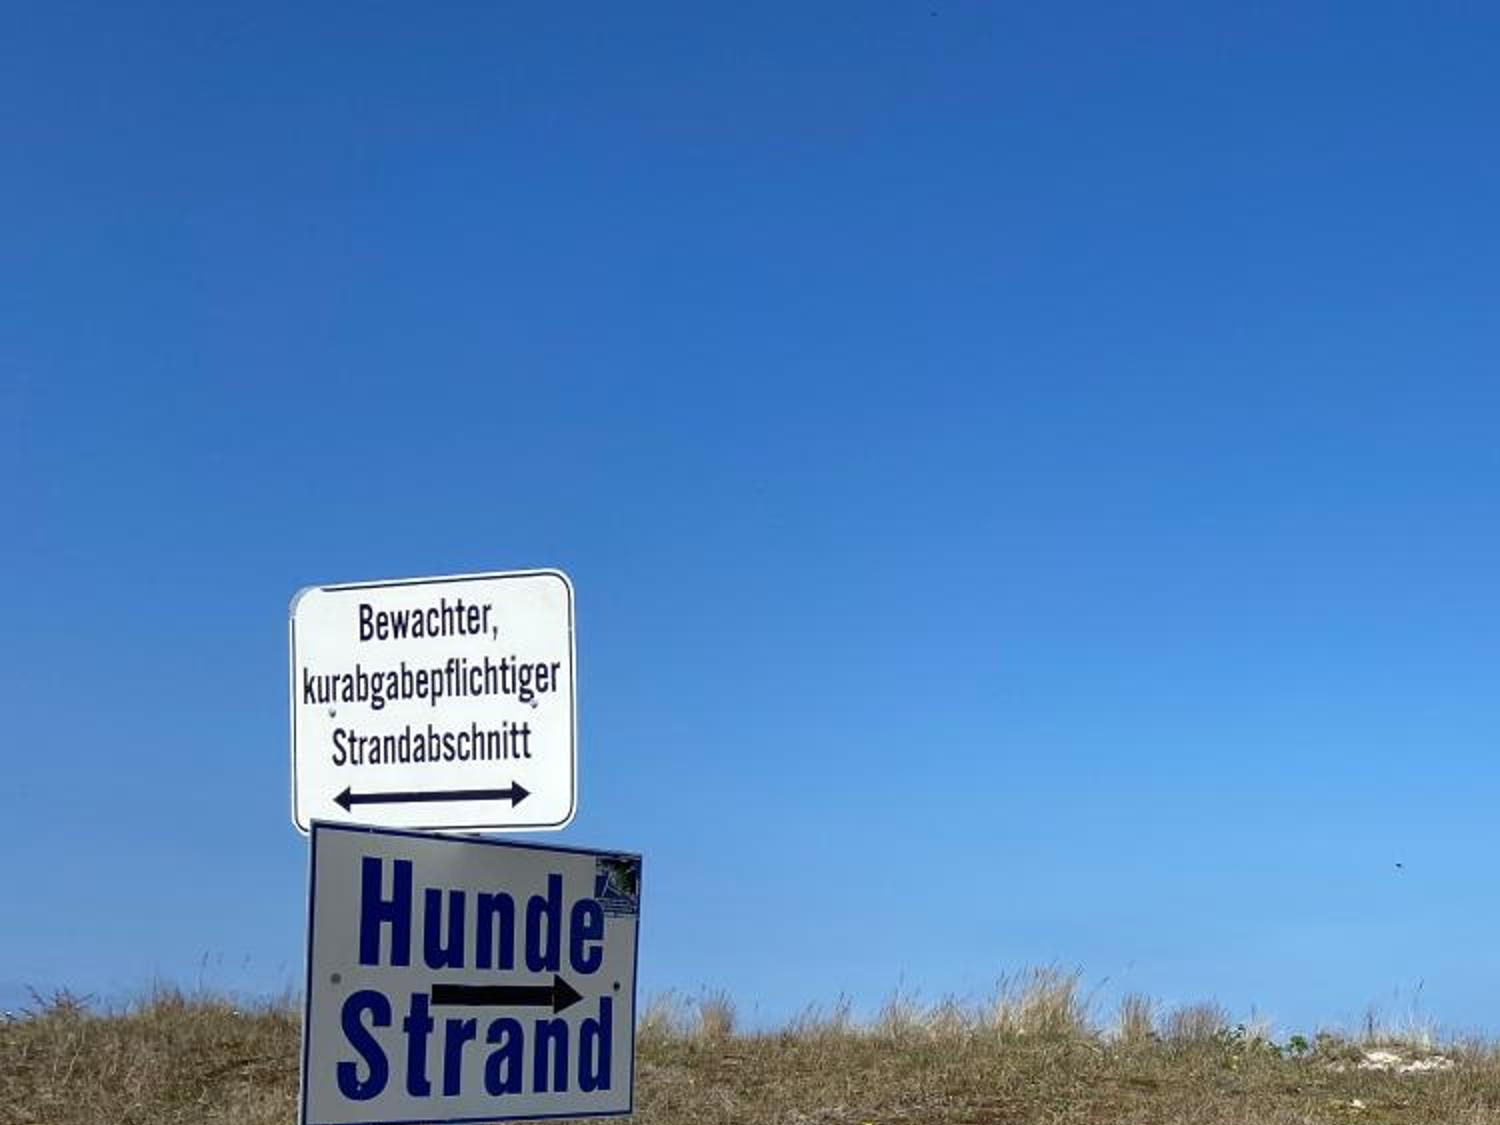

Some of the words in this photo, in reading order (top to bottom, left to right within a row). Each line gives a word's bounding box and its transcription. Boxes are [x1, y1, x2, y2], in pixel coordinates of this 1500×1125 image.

[359, 598, 498, 641] Bewachter,
[303, 655, 561, 710] kurabgabepflichtiger
[332, 721, 532, 766] Strandabschnitt
[359, 856, 604, 975] Hunde
[337, 989, 613, 1101] Strand
